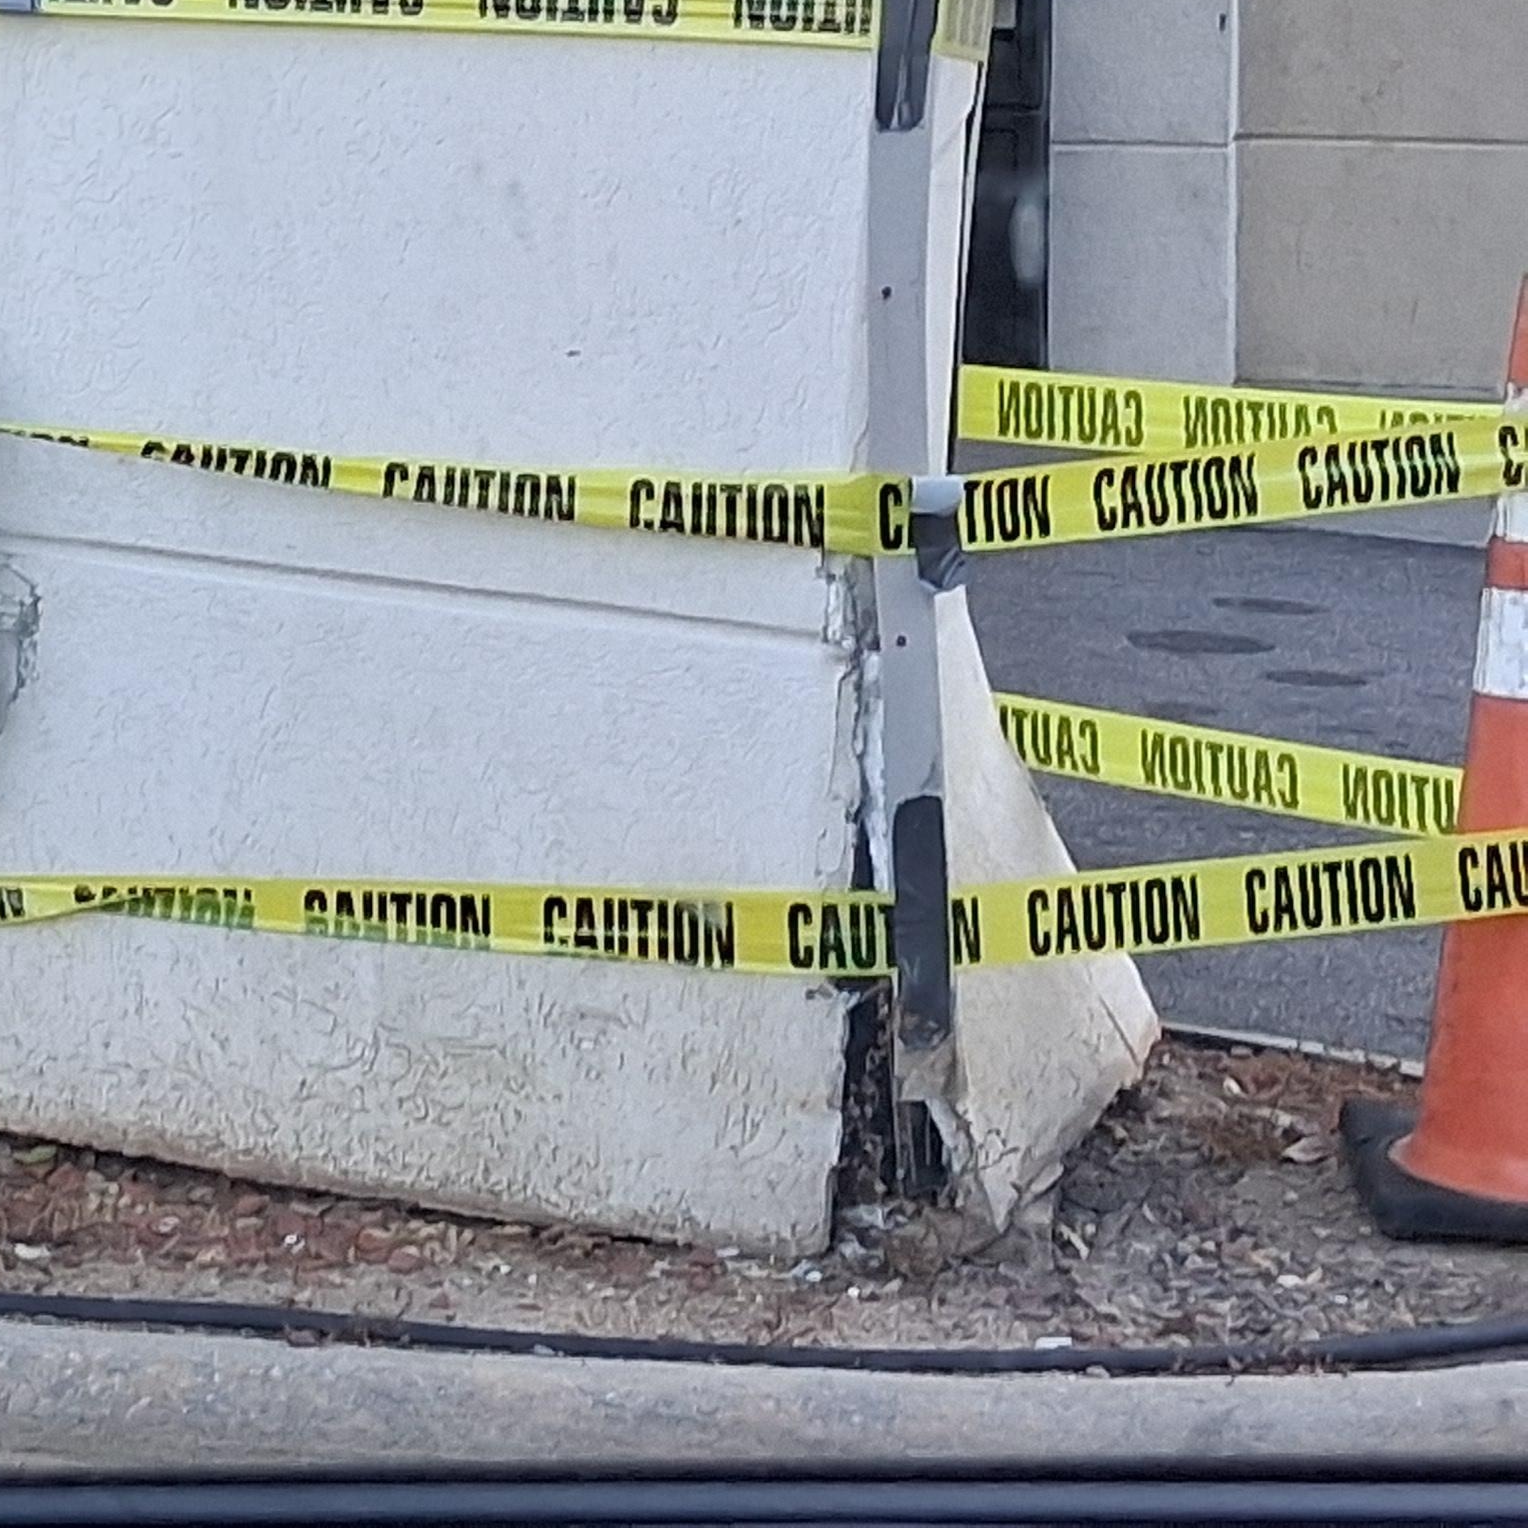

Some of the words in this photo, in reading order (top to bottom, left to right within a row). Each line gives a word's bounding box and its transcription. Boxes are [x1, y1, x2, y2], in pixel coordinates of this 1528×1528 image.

[629, 480, 825, 548] CAUTION
[1094, 450, 1259, 531] CAUTION
[1299, 432, 1461, 509] CAUTION
[543, 896, 735, 969] CAUTION
[1028, 874, 1200, 957] CAUTION
[1245, 853, 1416, 935] CAUTION
